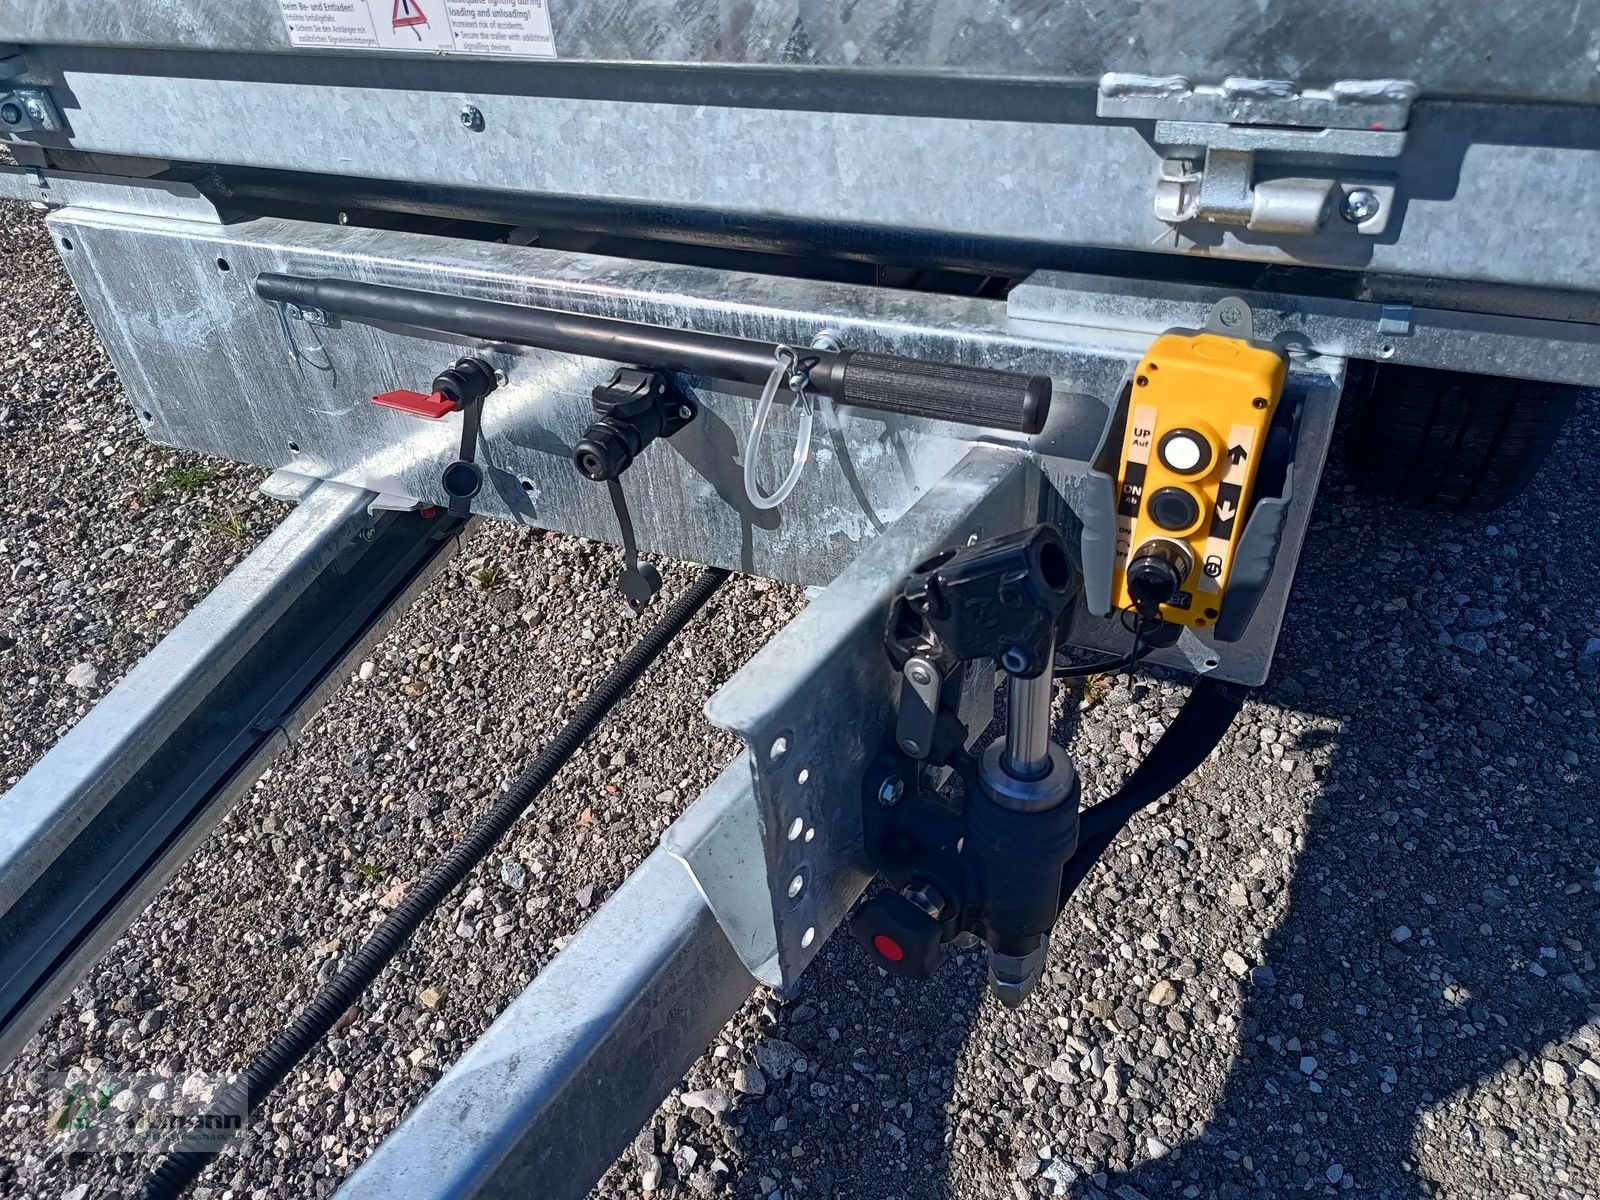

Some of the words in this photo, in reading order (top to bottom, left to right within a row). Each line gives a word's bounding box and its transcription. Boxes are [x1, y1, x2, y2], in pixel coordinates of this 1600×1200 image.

[282, 2, 298, 11] beim
[298, 2, 309, 11] Be-
[310, 2, 323, 11] und
[323, 3, 355, 12] Entladen!
[448, 7, 476, 19] loading
[477, 8, 491, 17] and
[492, 9, 531, 21] unloading!
[313, 24, 322, 32] Sie
[322, 25, 332, 33] den
[357, 26, 367, 34] mit
[451, 20, 478, 28] Increased
[478, 20, 488, 28] risk
[489, 20, 497, 29] of
[497, 22, 525, 30] accidents.
[460, 31, 479, 39] Secure
[480, 31, 490, 39] the
[490, 32, 507, 40] trailer
[508, 33, 522, 41] with
[522, 33, 550, 42] additional
[1133, 427, 1151, 438] UP
[1132, 439, 1149, 448] Auf
[1123, 484, 1142, 496] DN
[1125, 496, 1138, 505] Ab
[1118, 527, 1132, 535] ON
